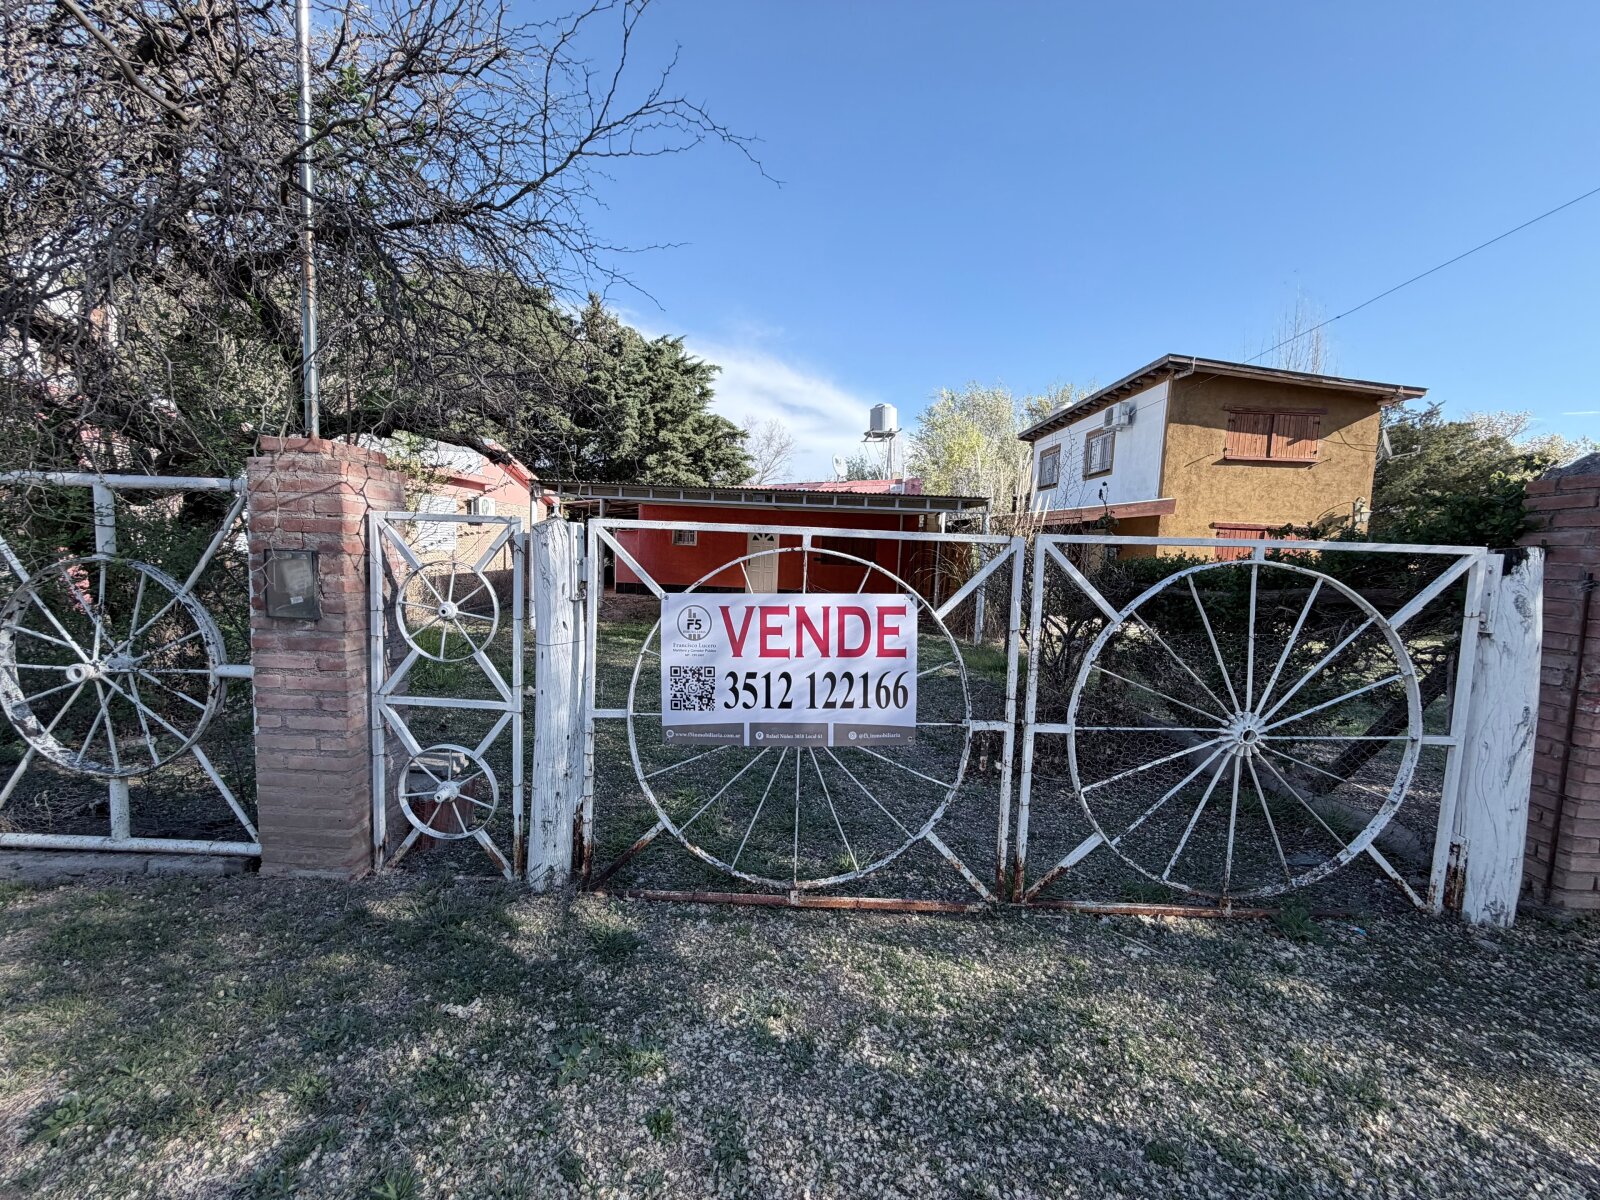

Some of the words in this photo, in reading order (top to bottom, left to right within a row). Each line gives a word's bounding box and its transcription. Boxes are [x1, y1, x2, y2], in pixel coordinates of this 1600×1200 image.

[687, 619, 702, 630] F5
[718, 604, 907, 660] VENDE
[724, 671, 793, 710] 3512
[806, 671, 909, 710] 122166
